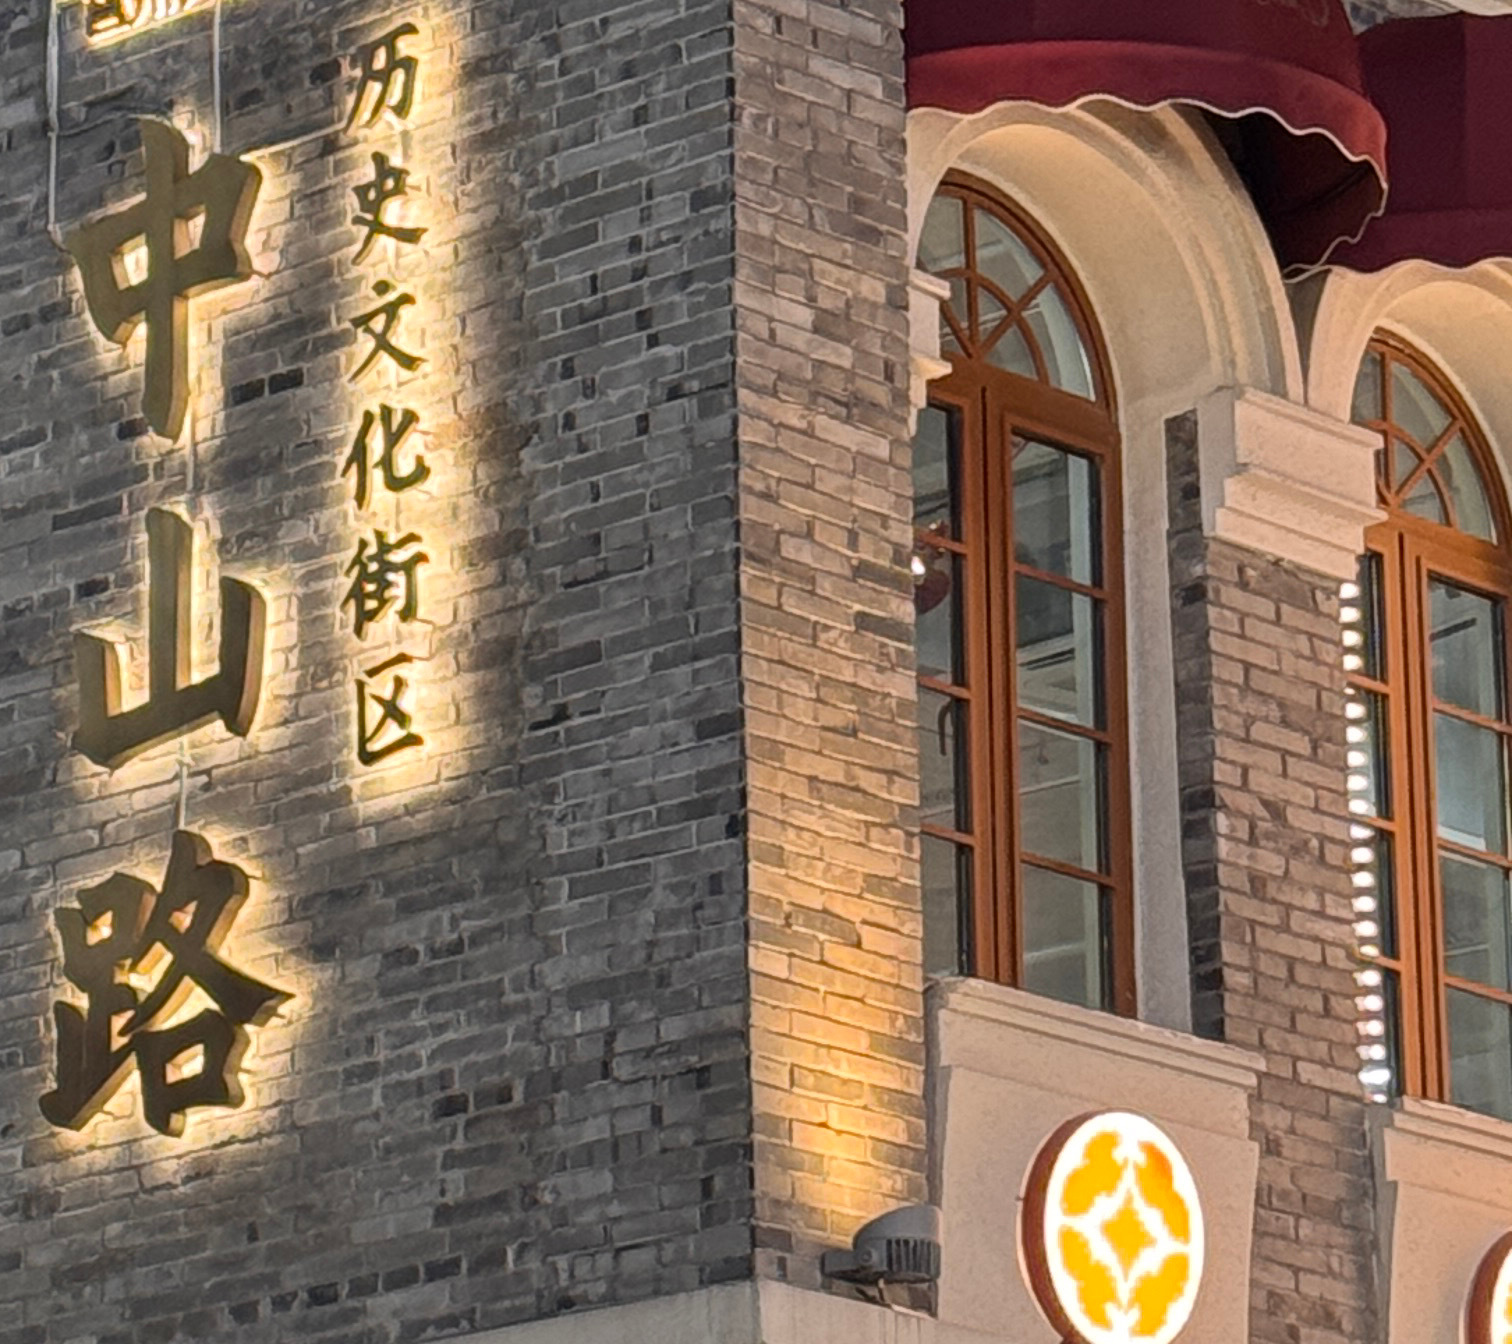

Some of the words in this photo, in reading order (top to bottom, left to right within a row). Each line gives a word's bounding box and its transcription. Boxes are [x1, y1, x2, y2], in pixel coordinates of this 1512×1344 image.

[39, 115, 295, 1138] 中山路
[340, 22, 431, 766] 历史文化街区
